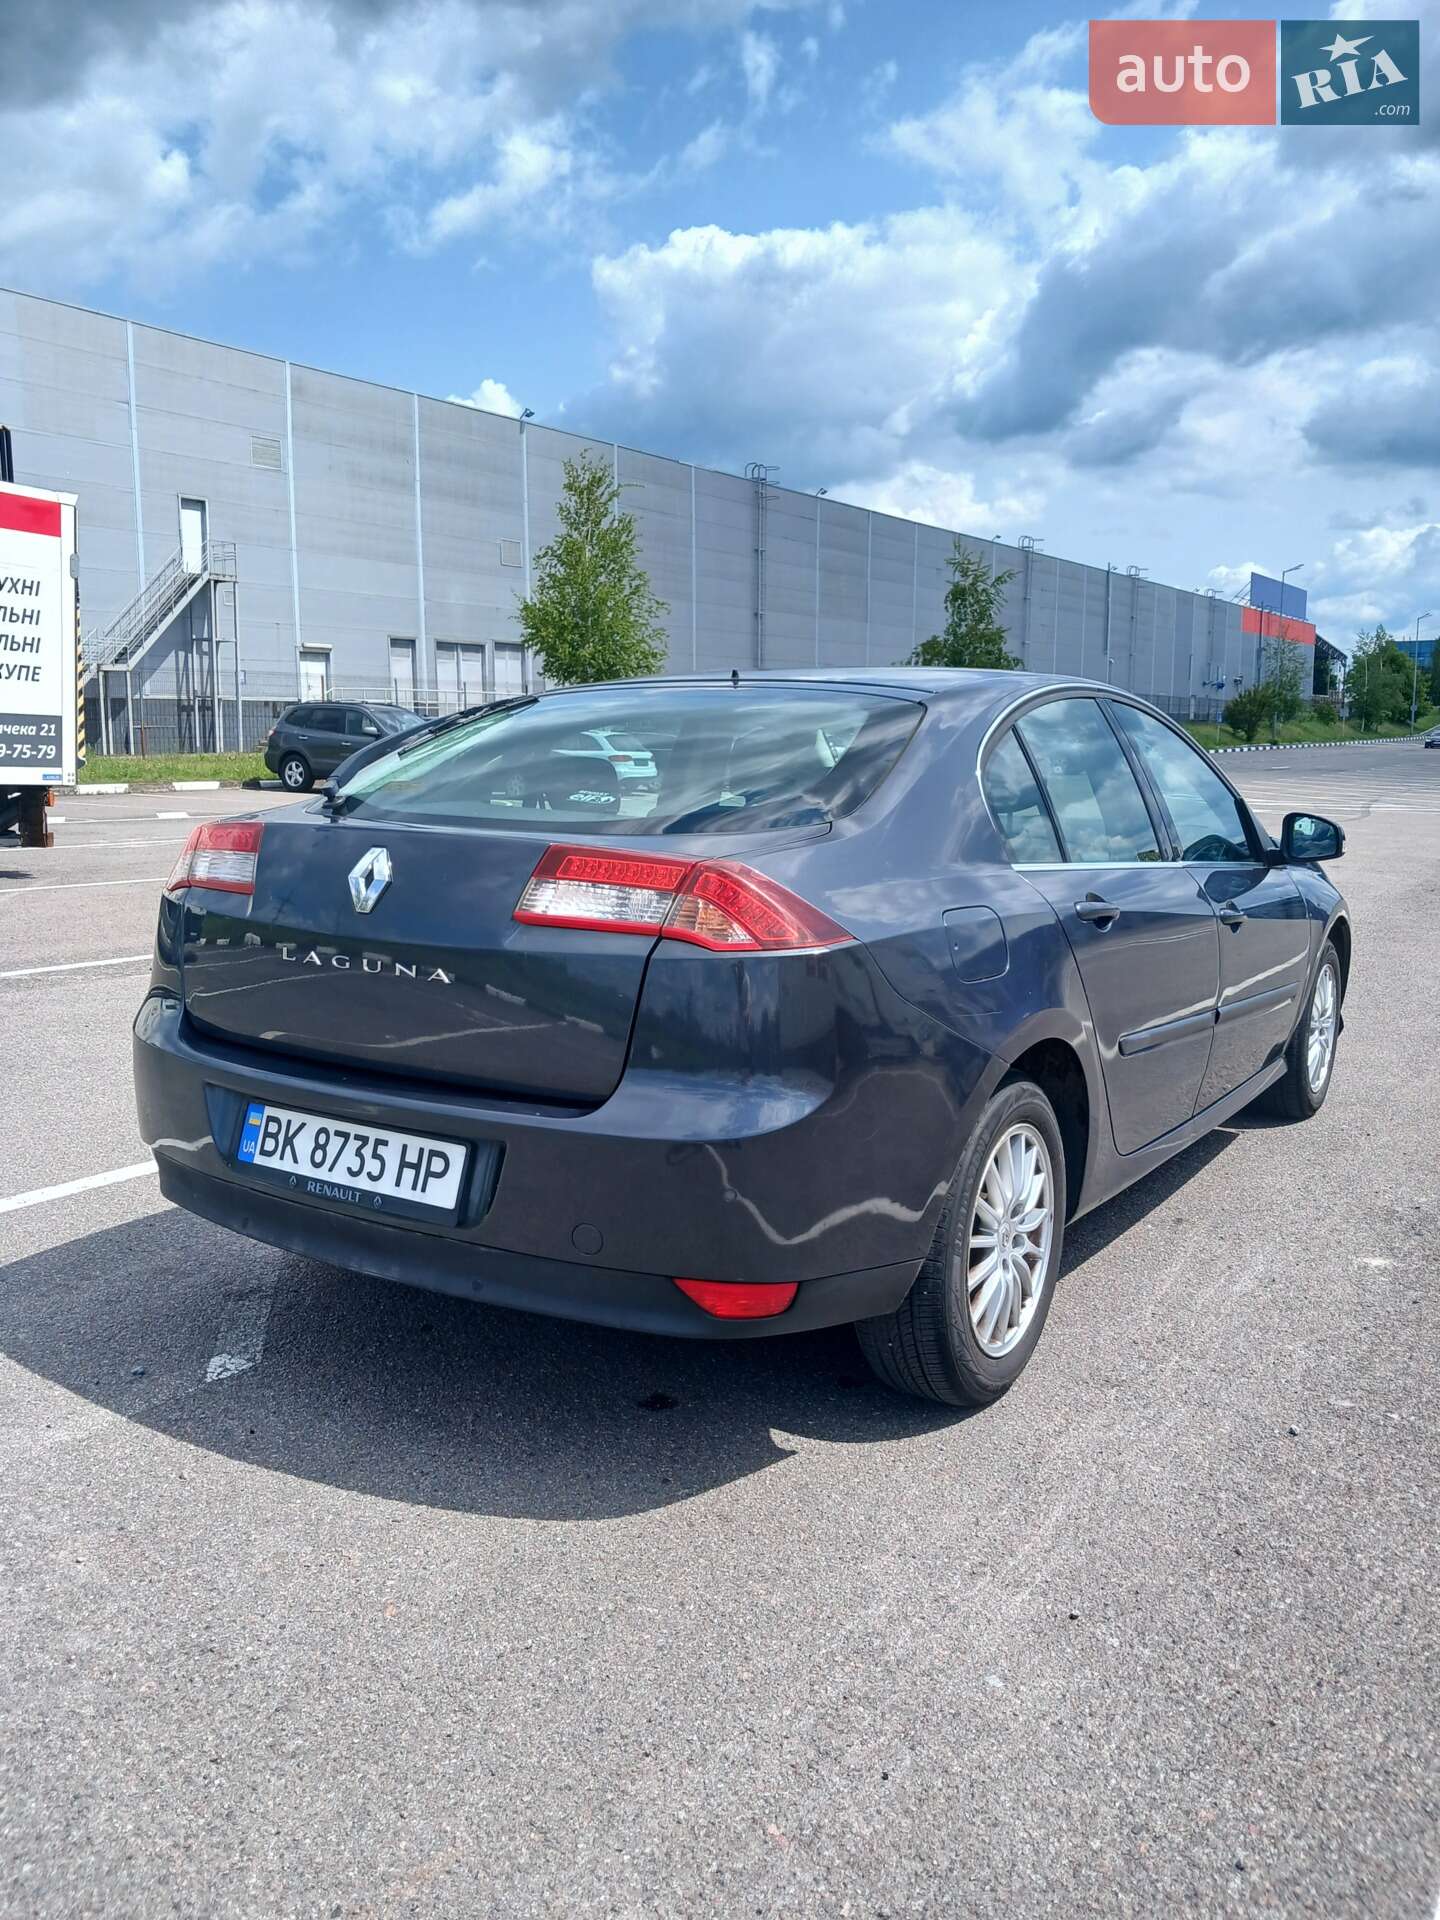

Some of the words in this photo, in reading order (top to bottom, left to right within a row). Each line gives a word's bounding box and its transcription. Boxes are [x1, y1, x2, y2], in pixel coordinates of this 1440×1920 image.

[39, 723, 56, 736] 21
[281, 946, 453, 984] LAGUNA
[242, 1141, 255, 1154] UA
[258, 1114, 307, 1165] BK
[309, 1126, 390, 1183] 8735
[394, 1142, 451, 1193] HP
[306, 1180, 362, 1204] RENAULT
